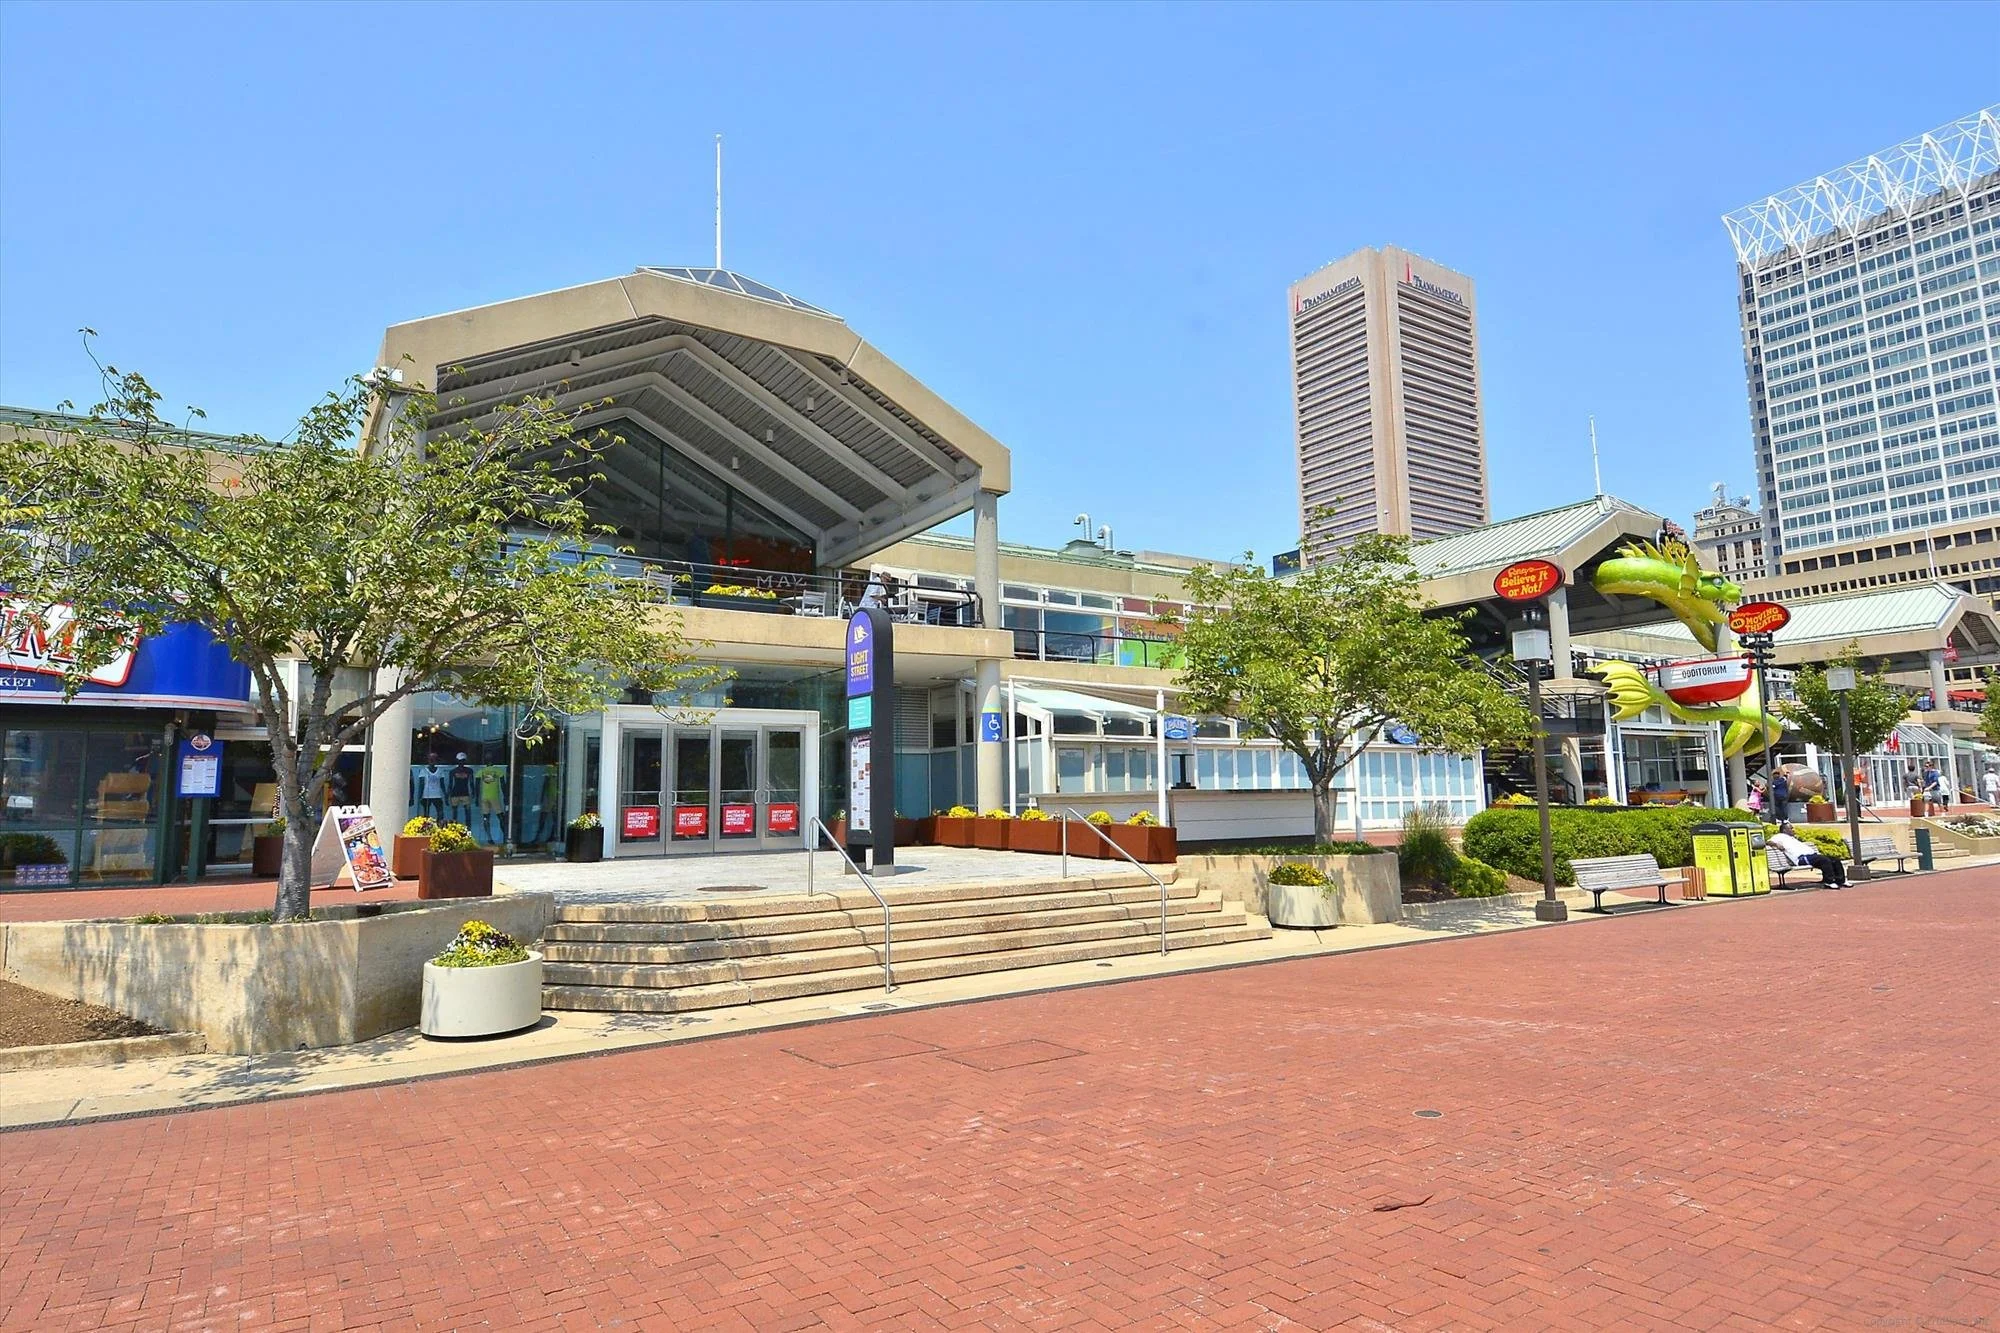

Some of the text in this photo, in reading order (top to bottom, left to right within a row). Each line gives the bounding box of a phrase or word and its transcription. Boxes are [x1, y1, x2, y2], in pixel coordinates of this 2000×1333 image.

[1303, 276, 1361, 309] TRANSAMERICA
[1413, 274, 1463, 305] TRANSAMERICA
[1501, 570, 1548, 588] Believe It
[1508, 581, 1542, 597] or Not!
[1745, 607, 1779, 625] MOVING
[1745, 614, 1783, 633] THEATER
[851, 650, 868, 665] LIGHT
[851, 664, 868, 677] STREET
